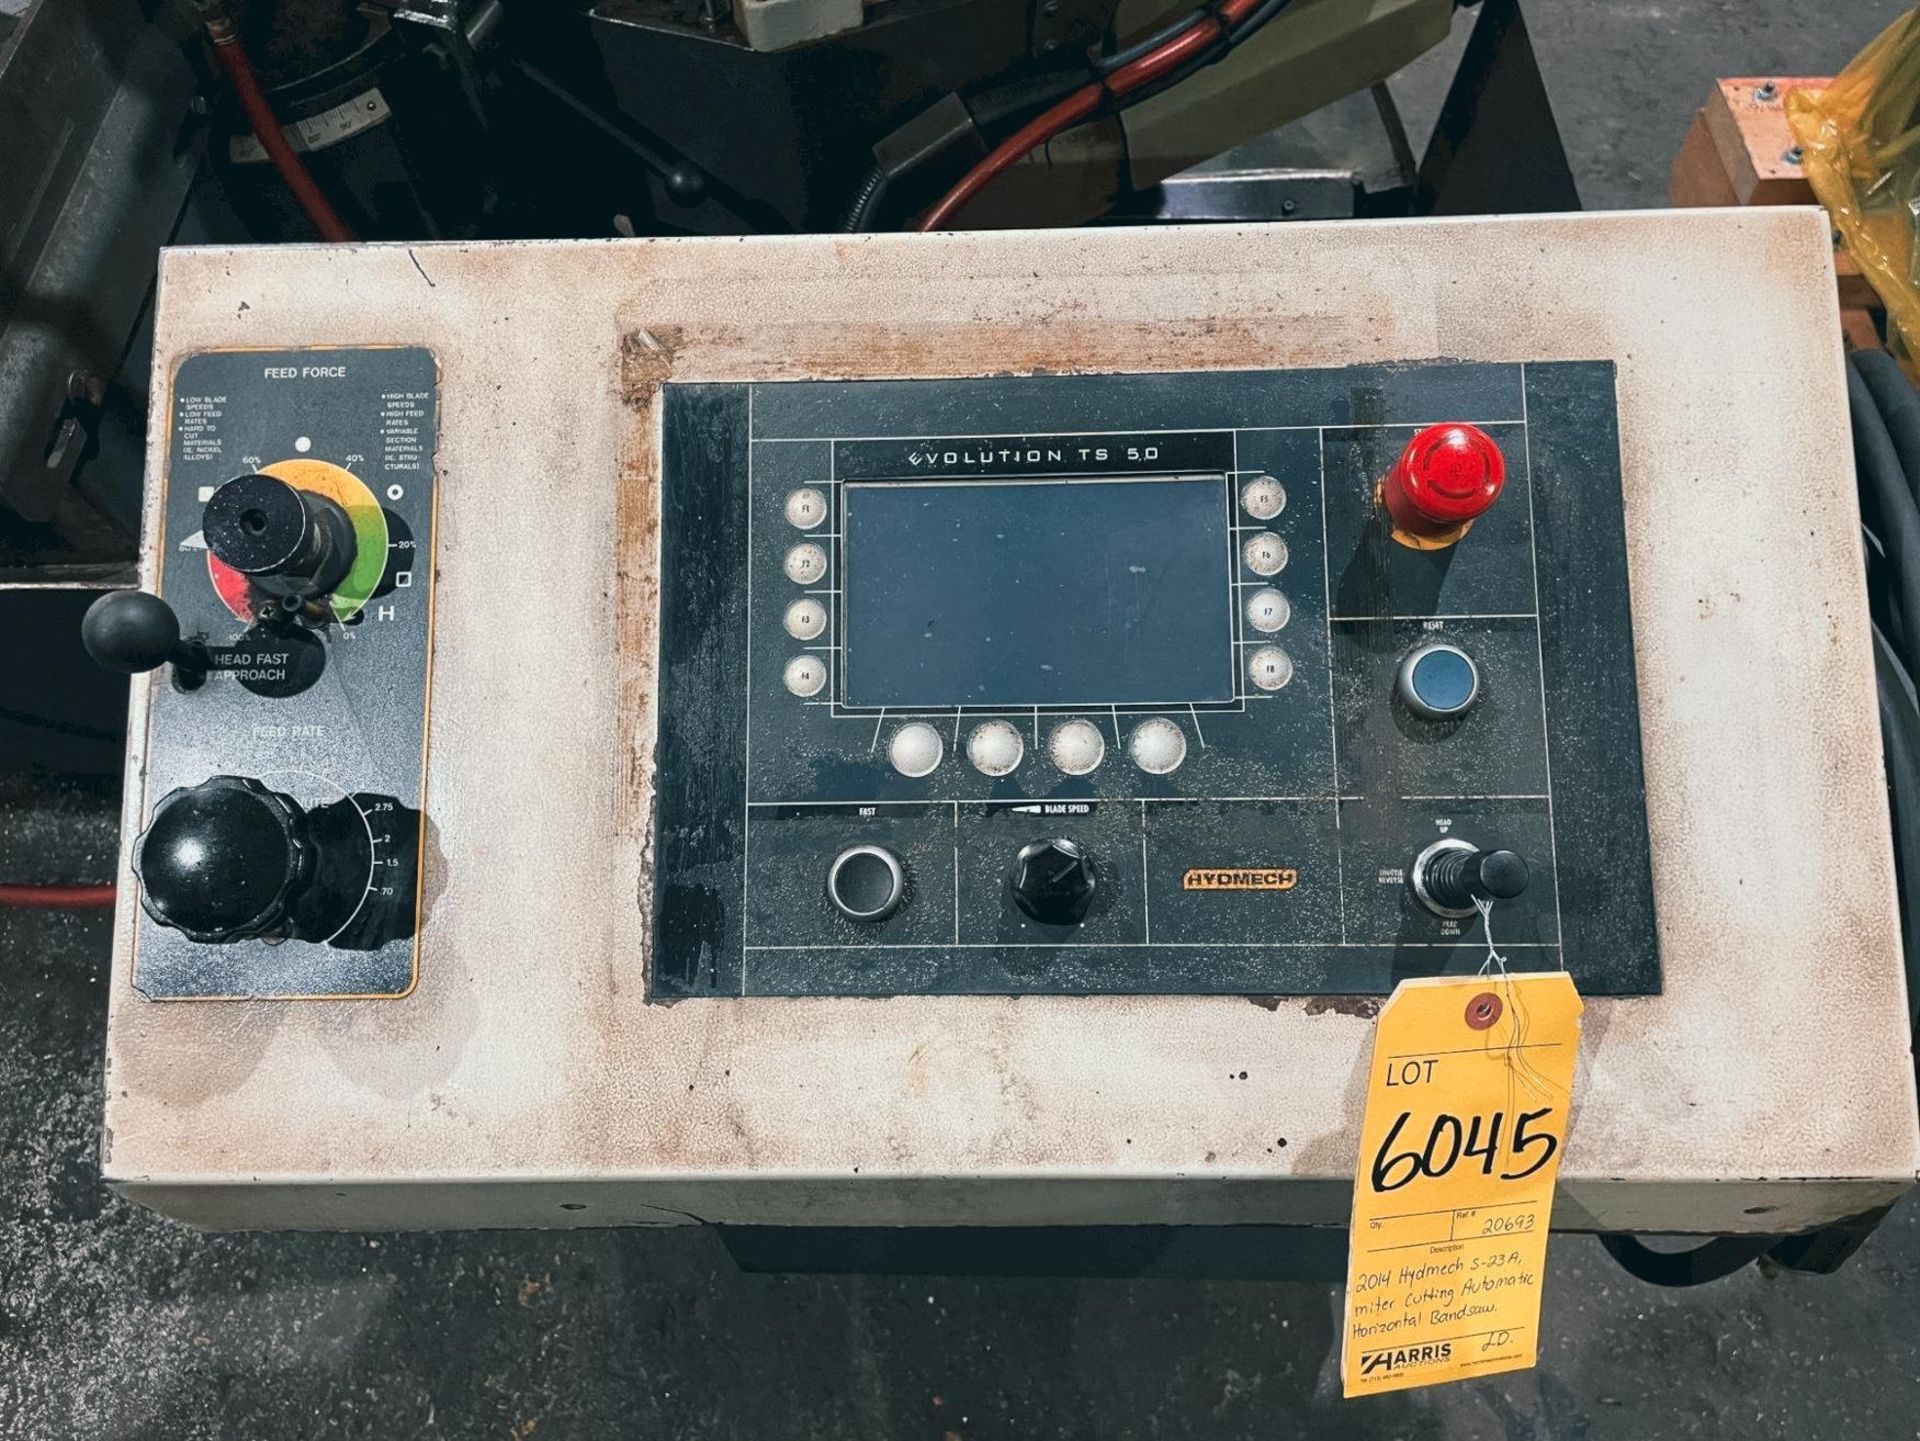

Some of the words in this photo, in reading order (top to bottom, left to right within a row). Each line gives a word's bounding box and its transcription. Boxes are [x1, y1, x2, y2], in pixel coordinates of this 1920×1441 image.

[264, 368, 297, 378] FEED
[302, 367, 346, 378] FORCE
[345, 454, 365, 463] 40%
[908, 449, 1062, 466] EVOLUTION
[1078, 448, 1109, 460] TS
[801, 505, 810, 513] F1
[398, 540, 417, 548] 20%
[801, 560, 810, 568] F2
[1264, 608, 1273, 616] F7
[1423, 621, 1444, 630] RESET
[215, 654, 251, 664] HEAD
[256, 653, 289, 664] FAST
[1266, 665, 1275, 673] F8
[214, 669, 286, 680] APPROACH
[801, 672, 810, 680] F4
[253, 727, 287, 738] FEED
[291, 726, 326, 738] RATE
[374, 802, 394, 811] 2.75
[859, 807, 877, 816] FAST
[1045, 805, 1066, 813] BLADE
[1068, 804, 1089, 813] SPEED
[384, 834, 391, 843] 2
[386, 858, 399, 867] 1.5
[1187, 873, 1293, 886] HYDMECH
[1386, 1059, 1438, 1086] LOT
[1371, 1107, 1557, 1193] 6045
[1482, 1214, 1535, 1234] 20693
[1430, 1244, 1464, 1254] Description
[1355, 1270, 1392, 1293] 2014
[1398, 1257, 1464, 1289] Hydmech
[1355, 1296, 1396, 1318] miter
[1461, 1273, 1535, 1297] Automatic
[1353, 1316, 1423, 1339] Horizontal
[1361, 1343, 1451, 1375] HARRIS
